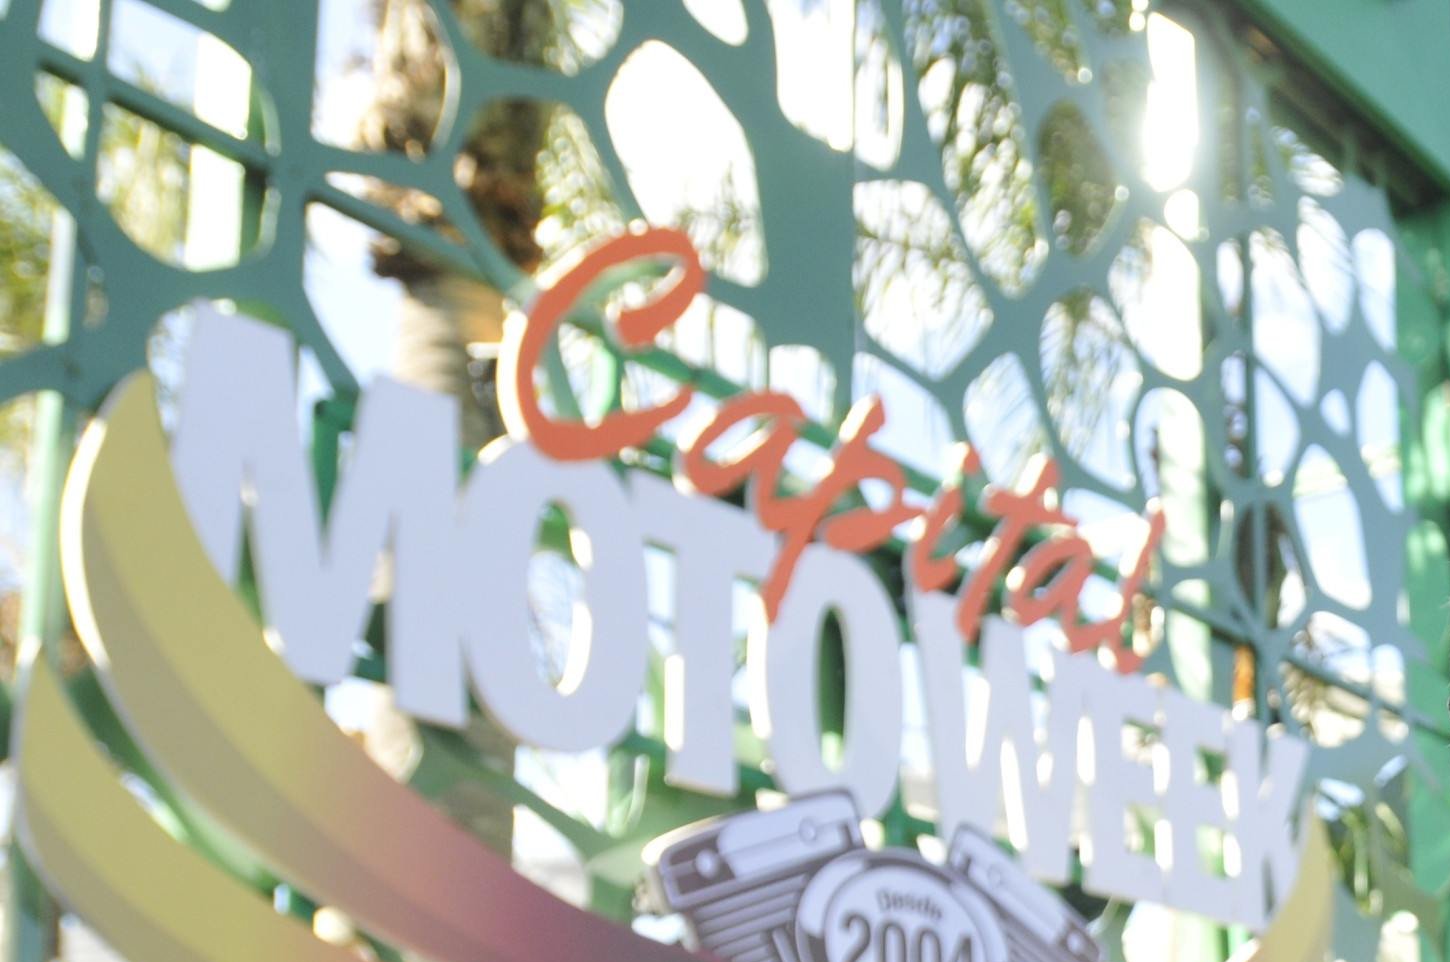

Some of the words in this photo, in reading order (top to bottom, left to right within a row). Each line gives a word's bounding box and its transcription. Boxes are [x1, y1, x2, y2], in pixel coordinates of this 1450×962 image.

[172, 298, 904, 820] MOTO
[906, 565, 1310, 936] WEEK
[500, 226, 1167, 675] Capital
